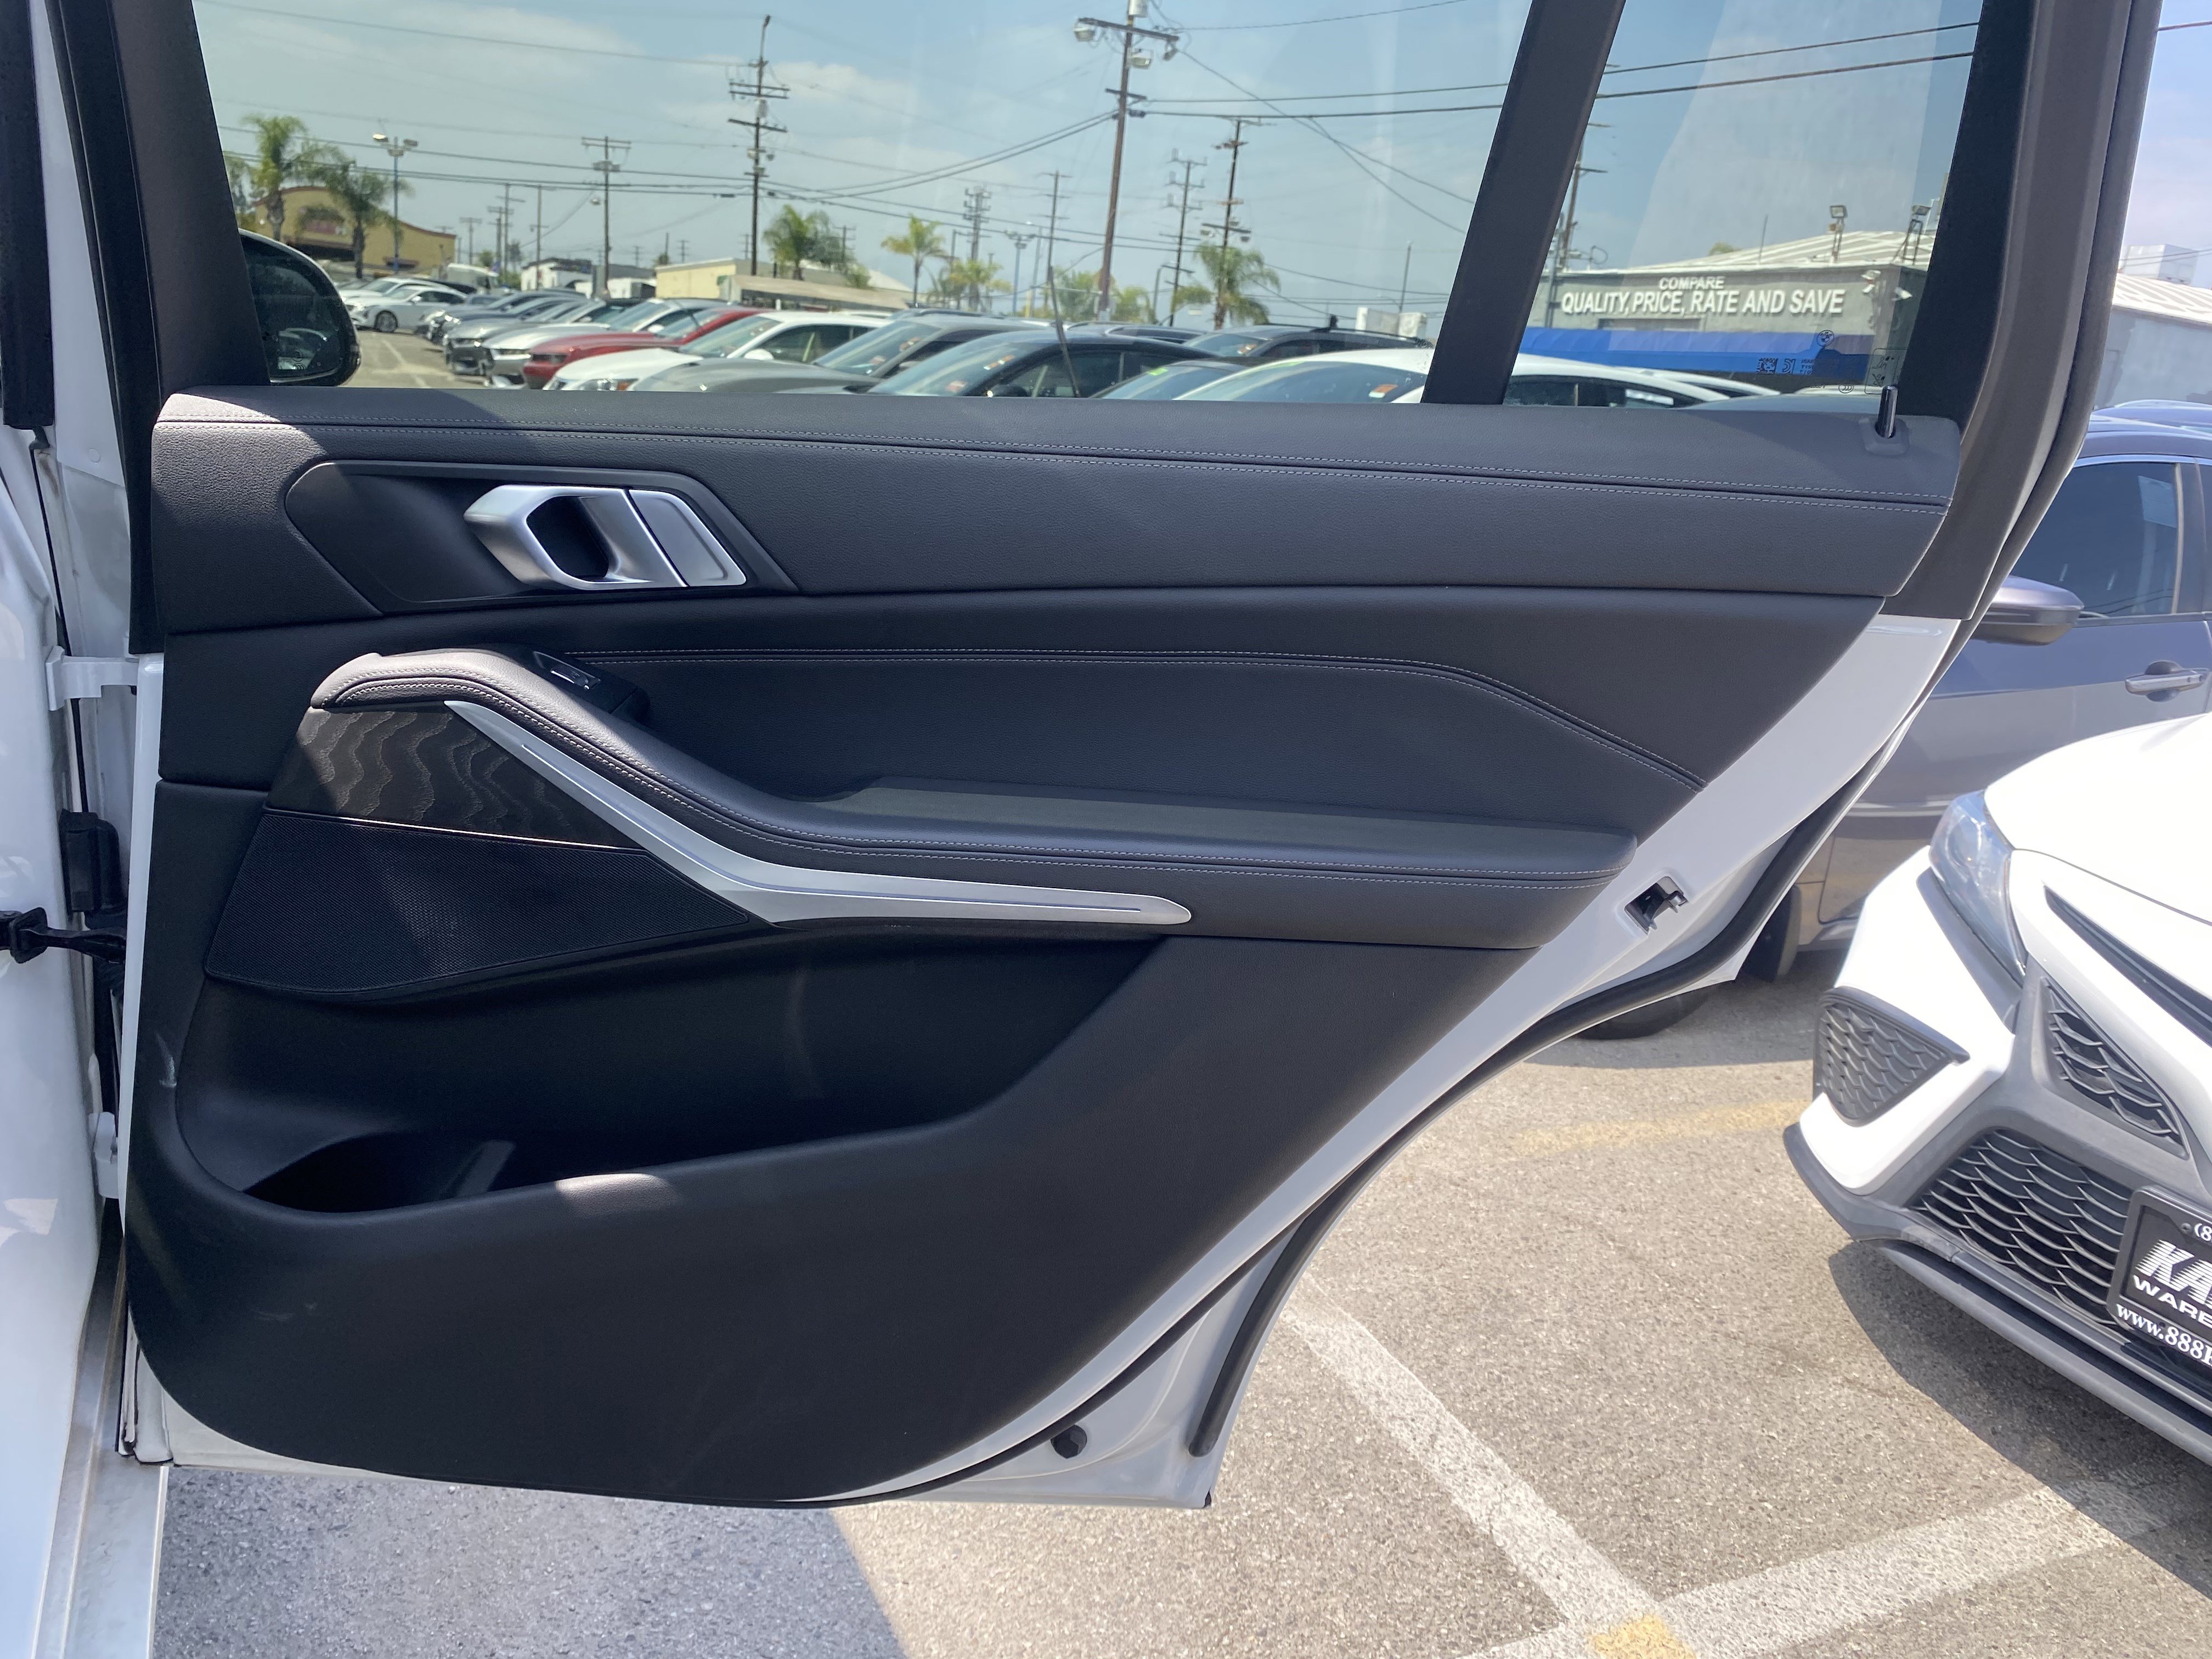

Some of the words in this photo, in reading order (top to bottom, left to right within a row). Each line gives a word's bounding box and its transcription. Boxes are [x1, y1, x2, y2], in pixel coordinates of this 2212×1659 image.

[1562, 291, 1629, 315] QUALITY,
[1632, 291, 1685, 315] PRICE,
[1690, 290, 1740, 313] RATE
[1742, 290, 1785, 313] AND
[1790, 289, 1846, 313] SAVE
[1659, 276, 1725, 290] COMPARE
[2135, 1239, 2212, 1309] KA
[2133, 1275, 2212, 1329] WARE
